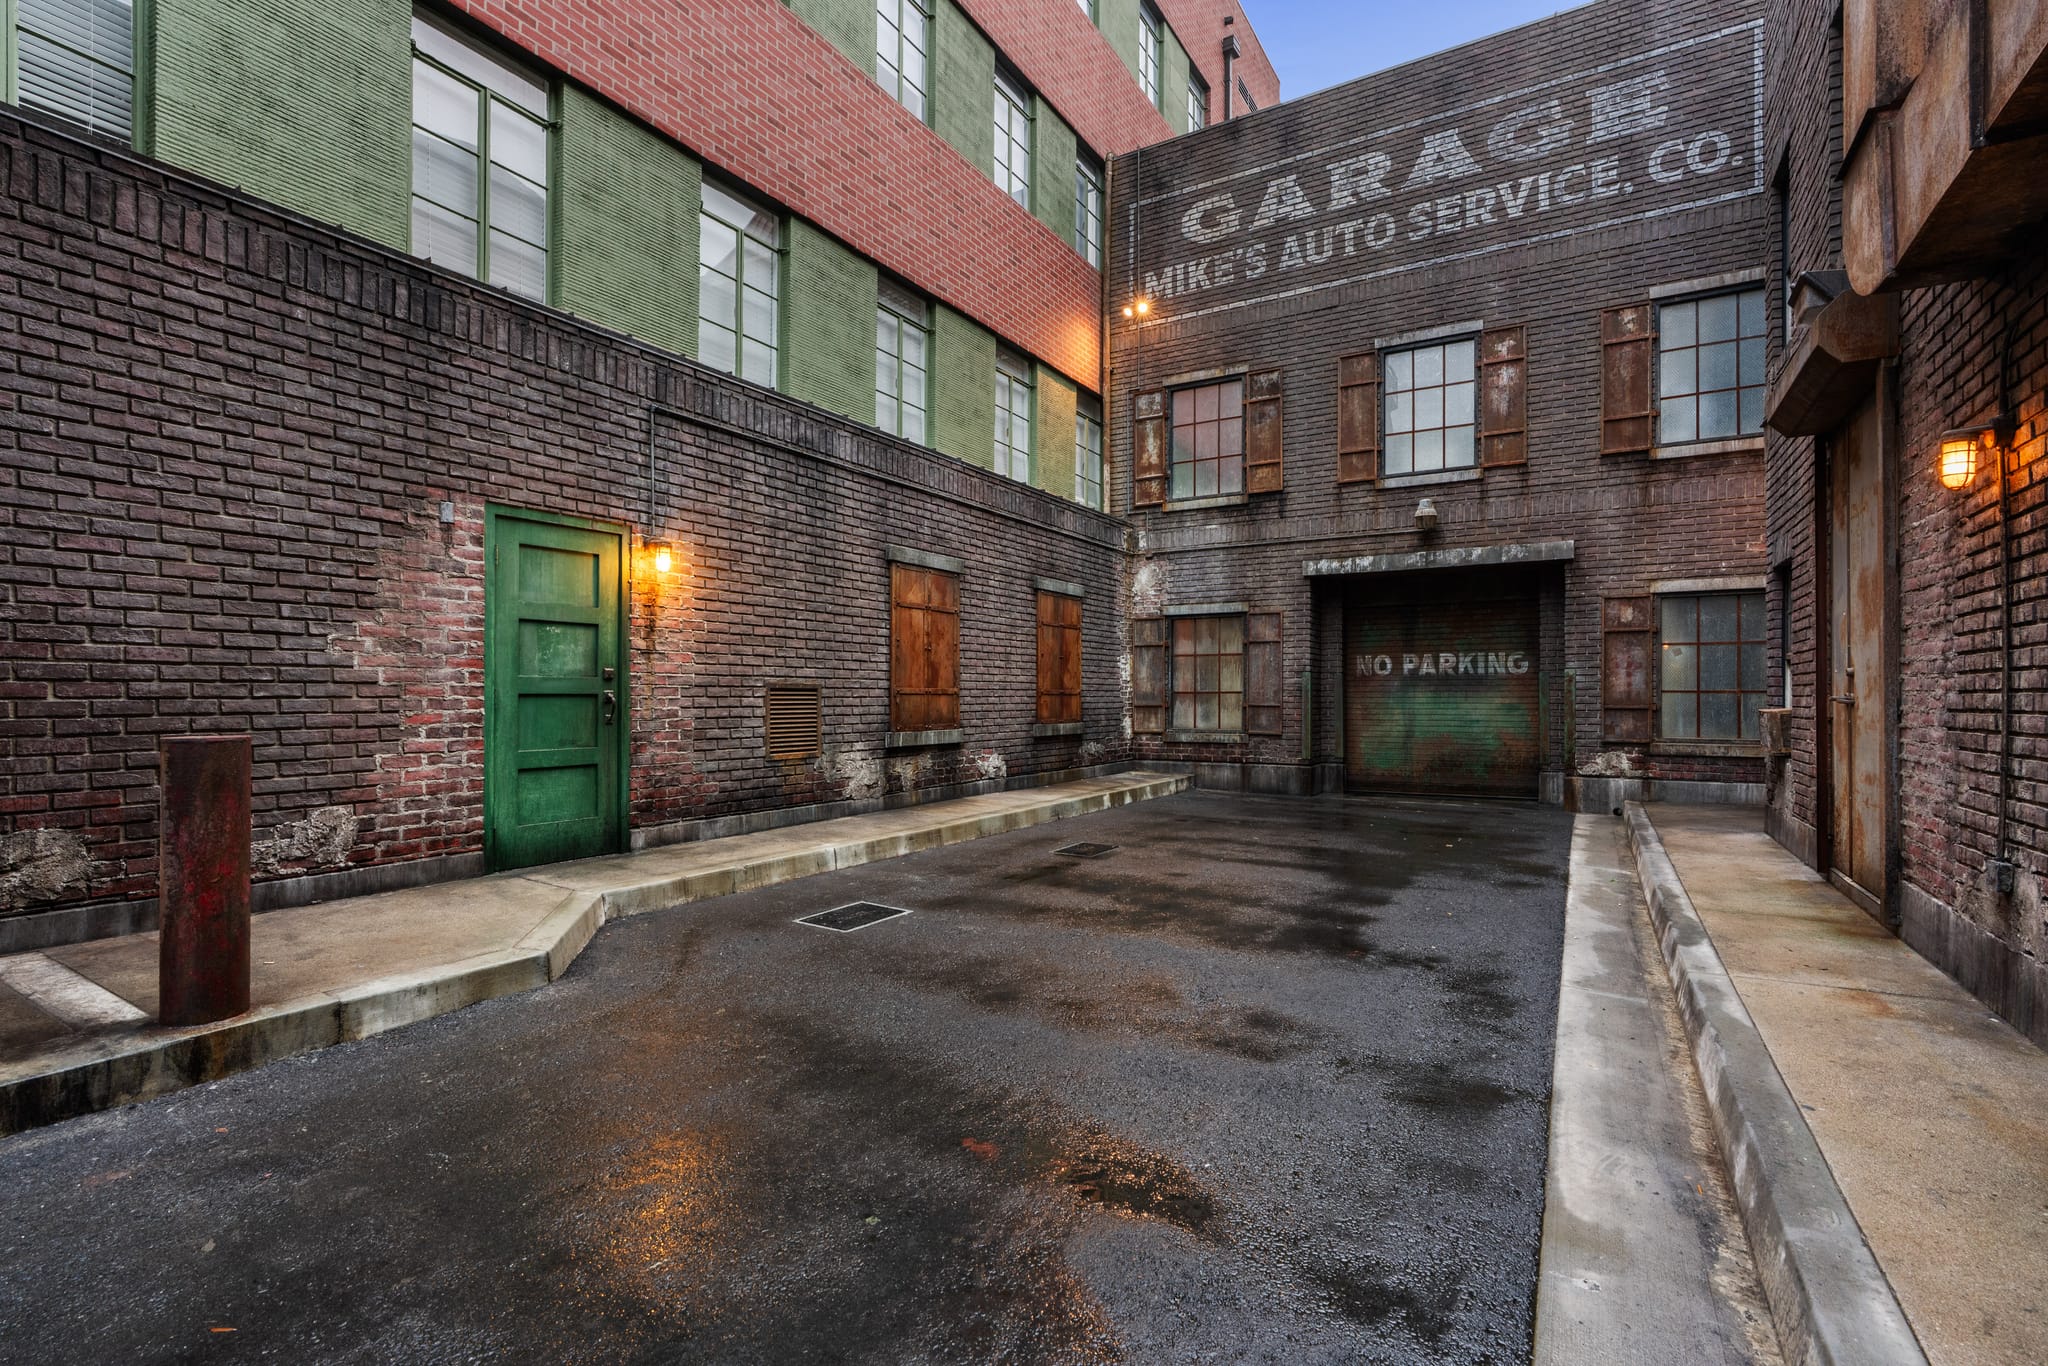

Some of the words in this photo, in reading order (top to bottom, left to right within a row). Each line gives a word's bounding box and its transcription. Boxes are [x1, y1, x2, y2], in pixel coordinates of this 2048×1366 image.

[1145, 242, 1268, 299] MIKE'S
[1280, 212, 1395, 269] AUTO
[1649, 130, 1743, 183] CO.
[1181, 70, 1670, 243] GARAGE
[1357, 655, 1392, 676] NO
[1402, 651, 1529, 675] PARKING
